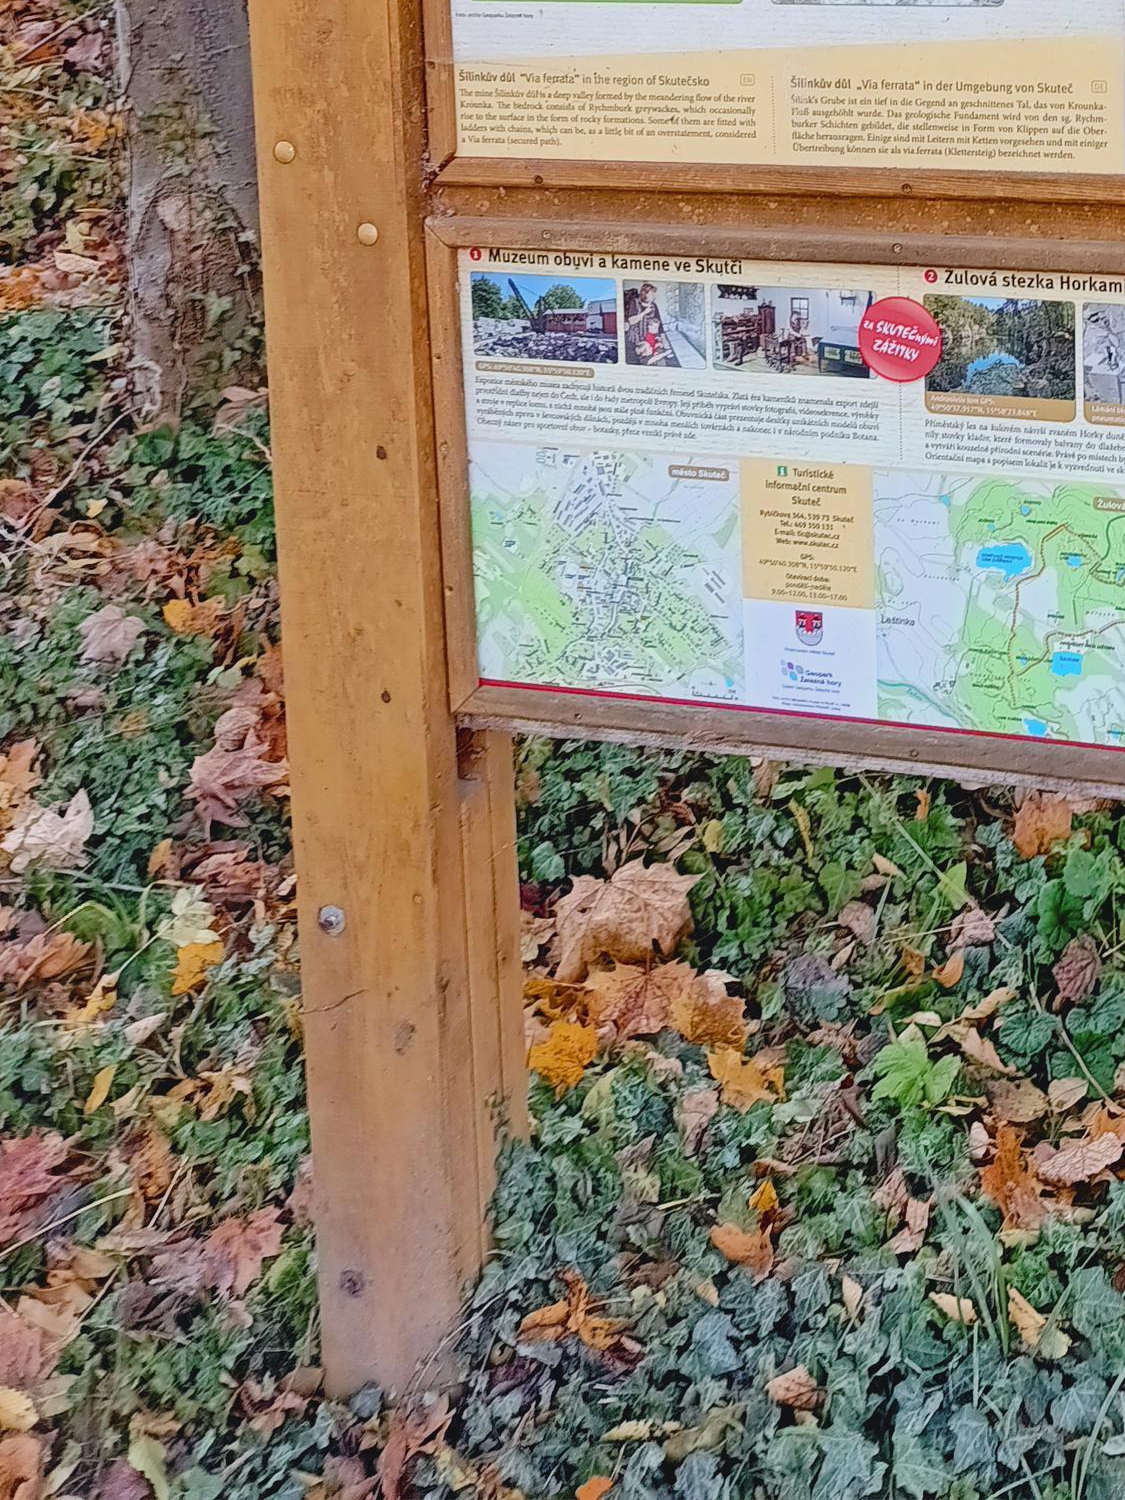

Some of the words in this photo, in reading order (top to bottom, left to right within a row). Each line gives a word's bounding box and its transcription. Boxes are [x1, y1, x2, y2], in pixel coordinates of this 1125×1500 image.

[458, 69, 498, 82] Šilinkův
[499, 72, 515, 82] důl
[582, 74, 591, 84] in
[593, 72, 610, 84] the
[612, 74, 644, 87] region
[645, 74, 657, 85] of
[658, 75, 710, 87] Skutečsko
[790, 75, 832, 89] Šilinkův
[834, 78, 851, 89] důl
[856, 78, 878, 91] „Via
[923, 80, 933, 90] in
[935, 80, 952, 91] der
[955, 81, 1012, 94] Umgebung
[1014, 84, 1034, 93] von
[1036, 82, 1073, 94] Skuteč
[488, 249, 550, 265] Muzeum
[554, 252, 594, 267] obuvi
[598, 258, 607, 268] a
[611, 255, 670, 271] kamene
[674, 262, 691, 272] ve
[695, 259, 742, 275] Skutči
[1002, 271, 1054, 289] stezka
[793, 468, 834, 479] Turistické
[765, 480, 810, 492] informační
[813, 484, 847, 494] centrum
[792, 495, 821, 506] Skuteč
